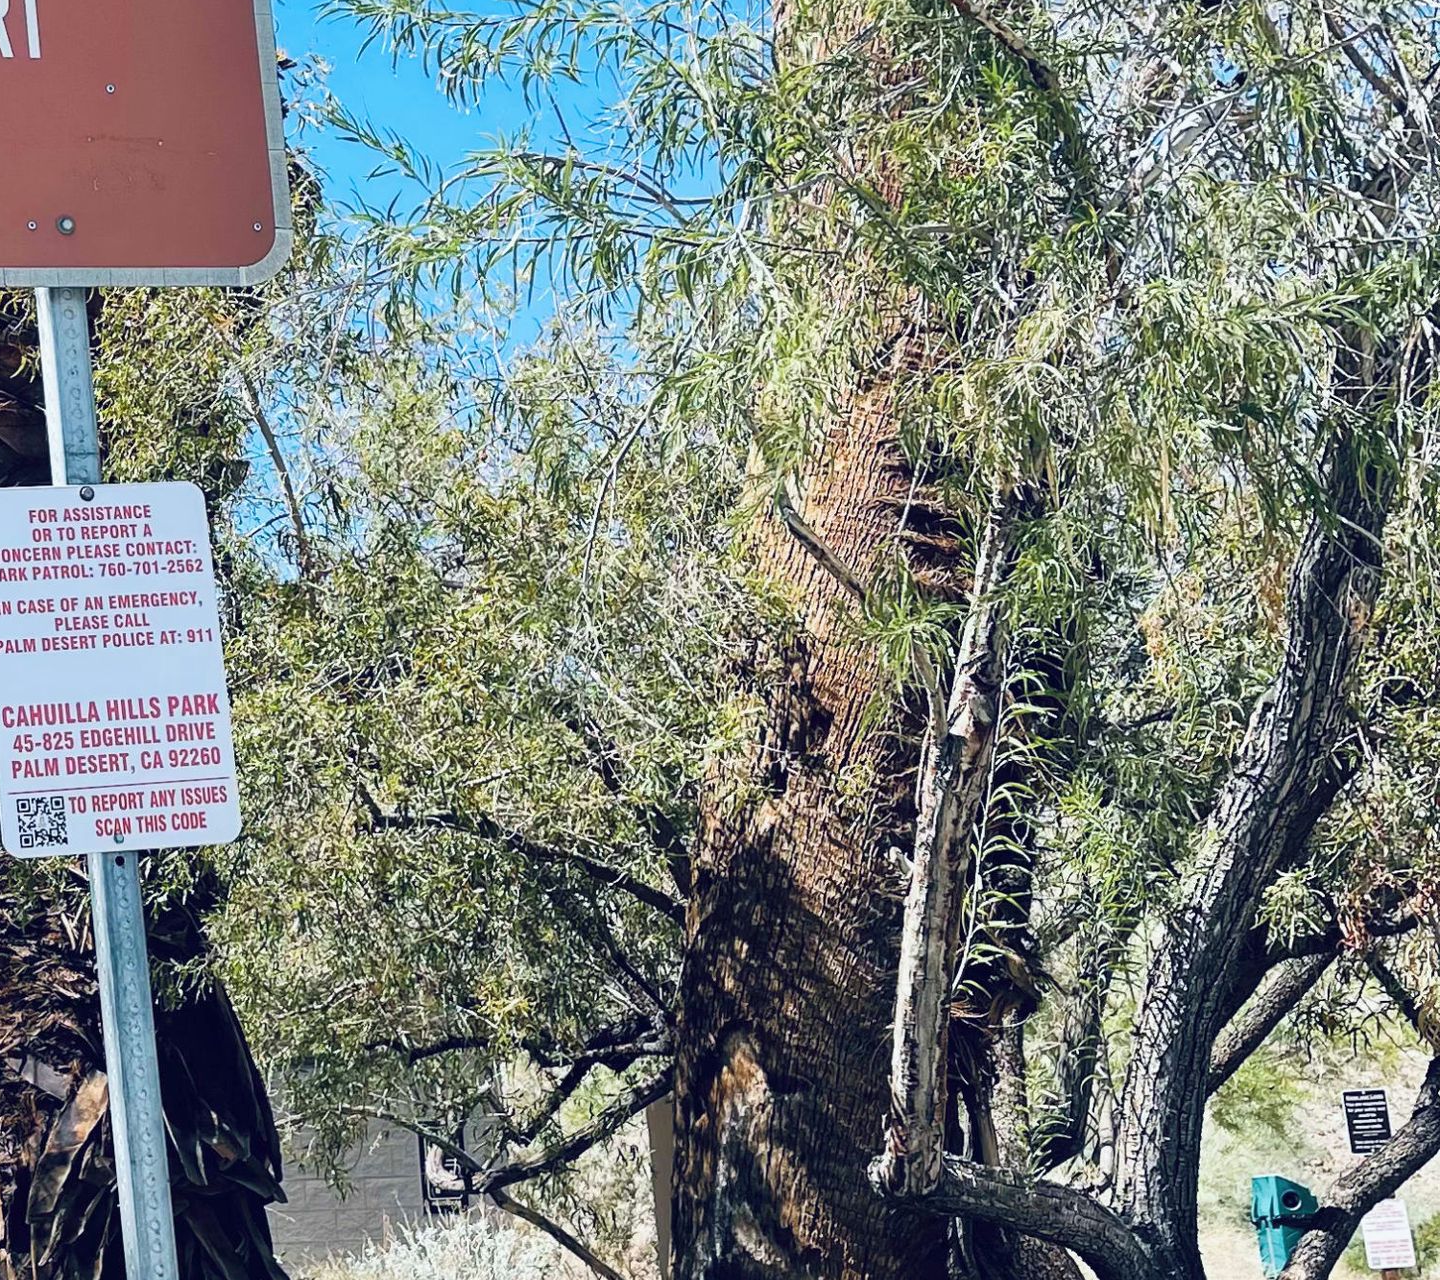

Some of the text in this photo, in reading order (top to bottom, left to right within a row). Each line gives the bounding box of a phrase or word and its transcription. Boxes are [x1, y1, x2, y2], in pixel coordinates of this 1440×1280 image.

[28, 505, 152, 524] FOR ASSISTANCE
[32, 523, 153, 543] OR TO REPORT A
[67, 544, 121, 560] PLEASE
[126, 540, 198, 557] CONTACT:
[32, 564, 95, 580] PATROL:
[98, 558, 204, 577] 760-701-2562
[17, 599, 55, 615] CASE
[60, 597, 79, 612] OF
[84, 596, 104, 611] AN
[109, 591, 204, 609] EMERGENCY,
[54, 613, 150, 632] PLEASE CALL
[42, 634, 97, 652] DESERT
[103, 632, 155, 649] POLICE
[160, 630, 183, 645] AT:
[186, 628, 213, 643] 911
[2, 693, 220, 729] CAHUILLA HILLS PARK
[13, 722, 216, 753] 45-825 EDGEHILL DRIVE
[11, 746, 221, 779] PALM DESERT, CA 92260
[68, 785, 228, 814] TO REPORT ANY ISSUES
[95, 811, 207, 837] SCAN THIS CODE
